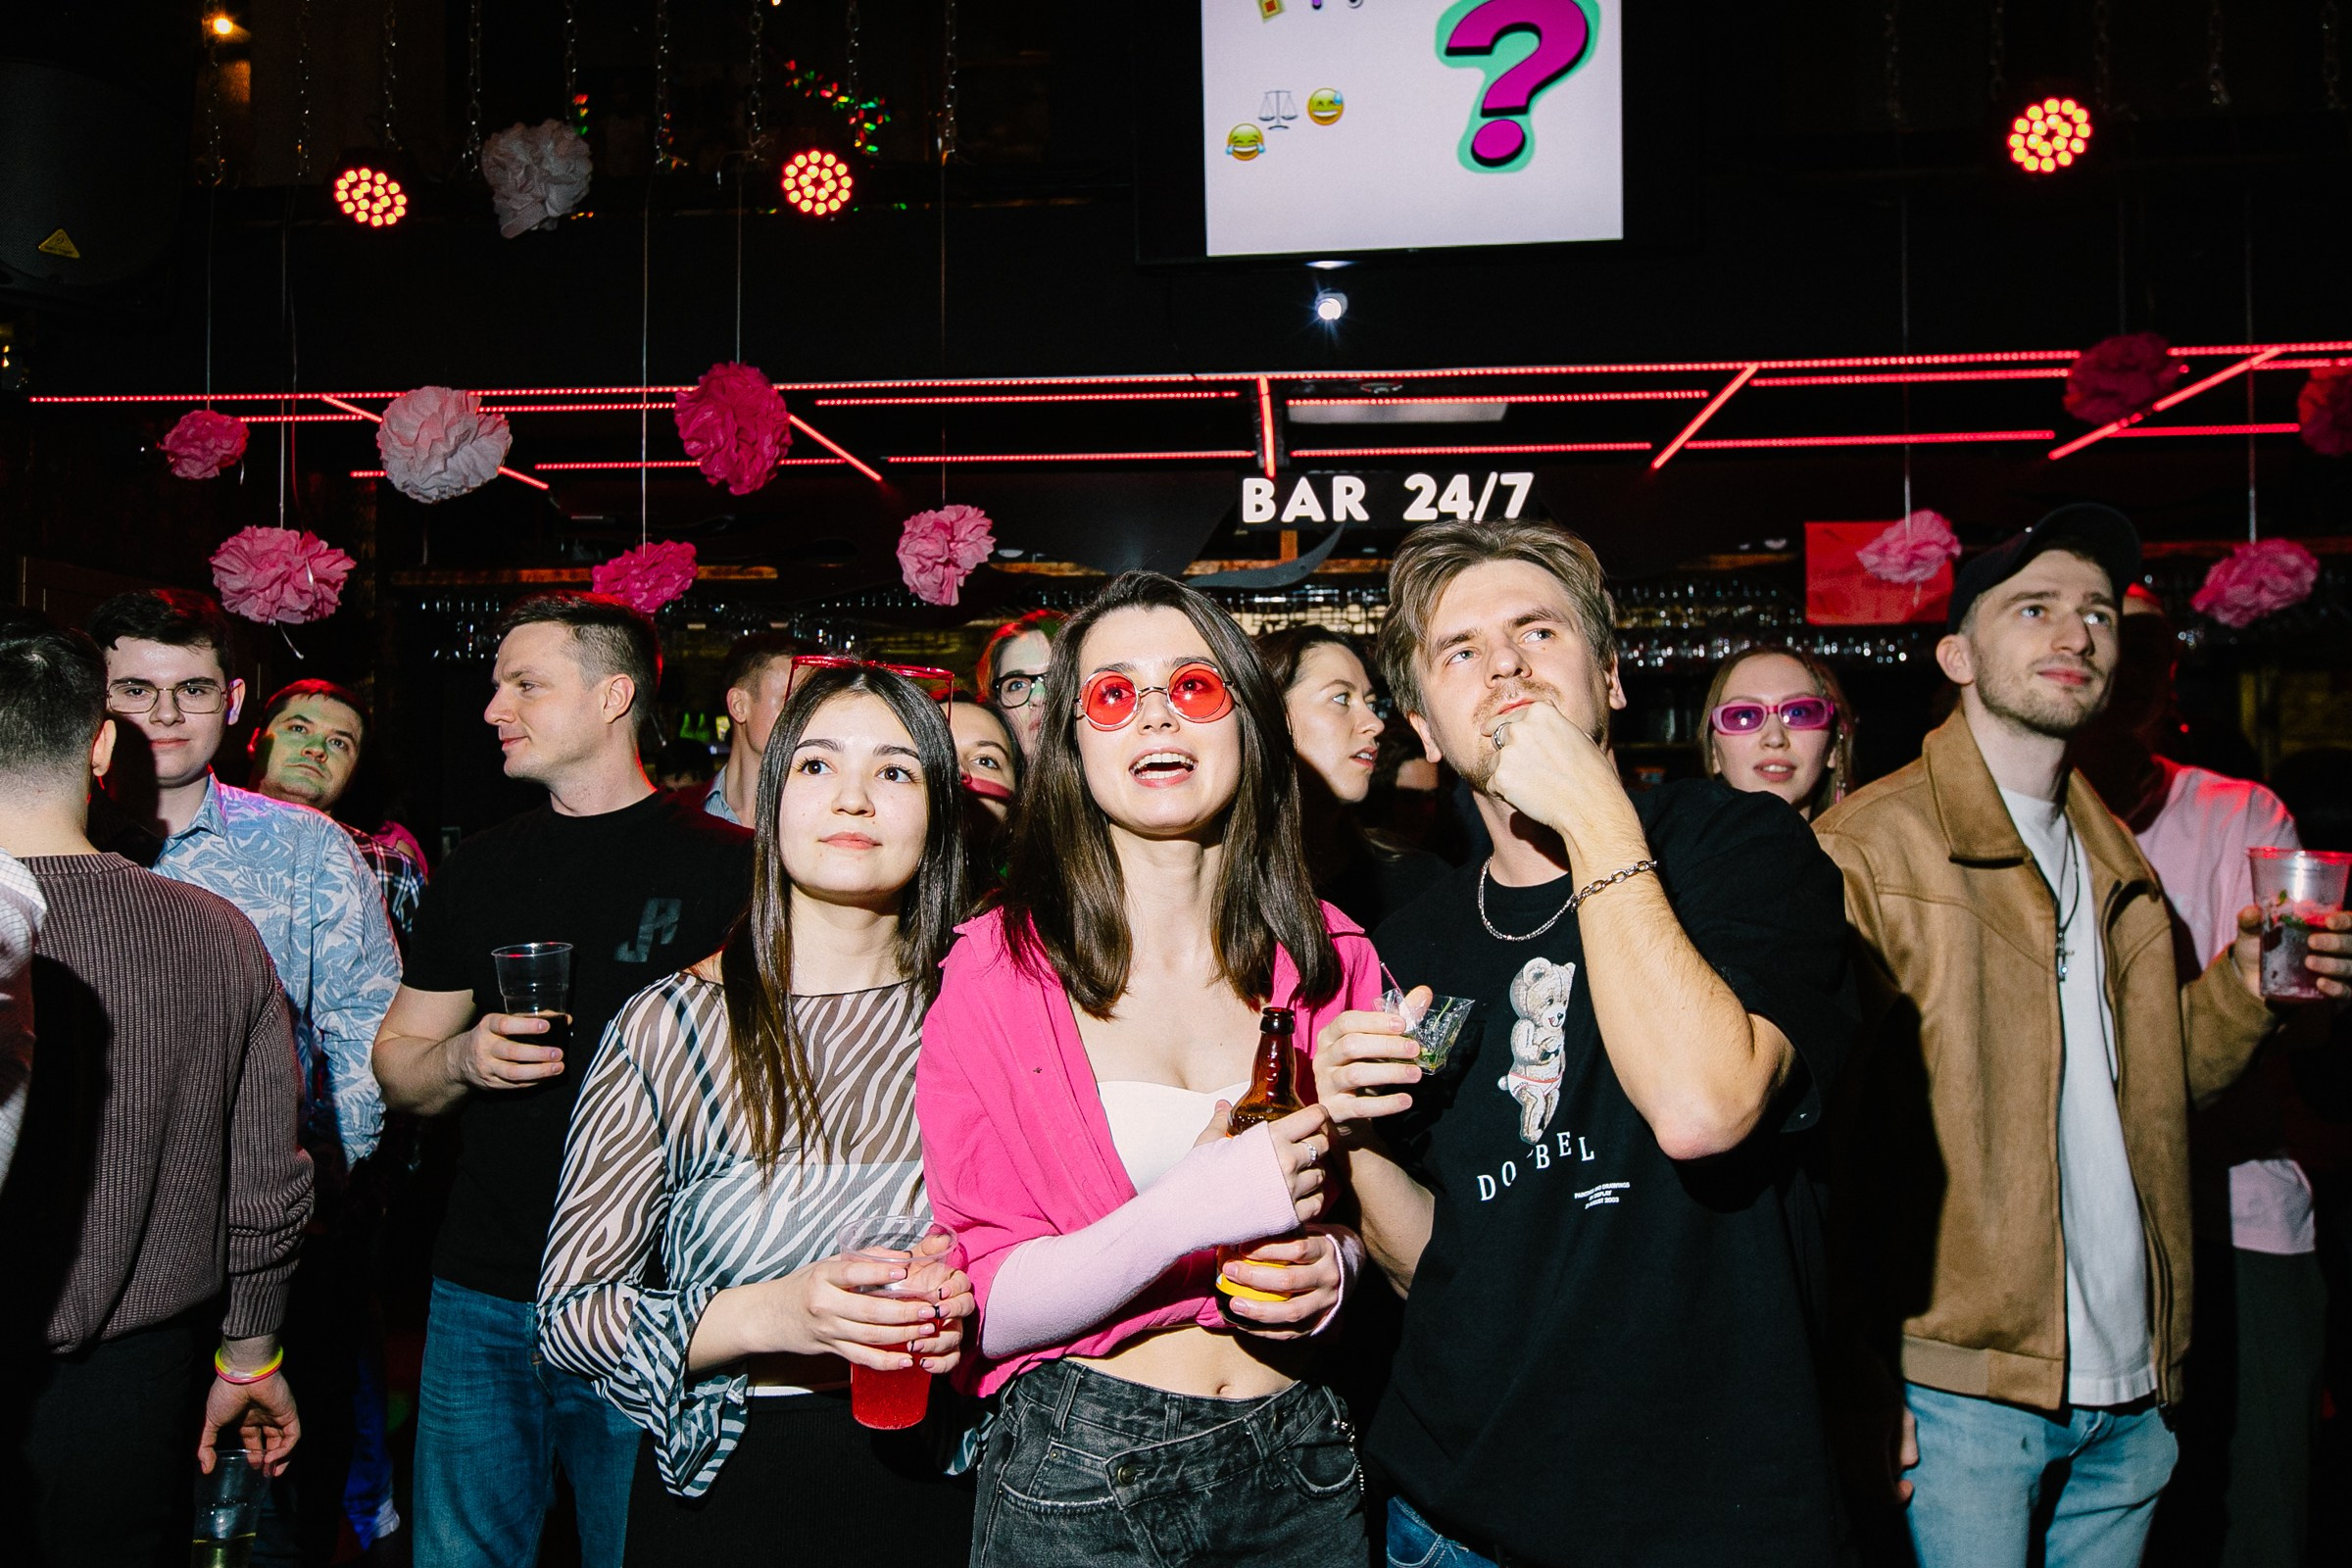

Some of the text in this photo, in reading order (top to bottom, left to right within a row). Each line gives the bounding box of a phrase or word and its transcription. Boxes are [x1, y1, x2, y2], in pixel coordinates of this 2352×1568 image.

[1242, 471, 1535, 523] BAR 24/7
[1477, 1131, 1594, 1201] DOBEL
